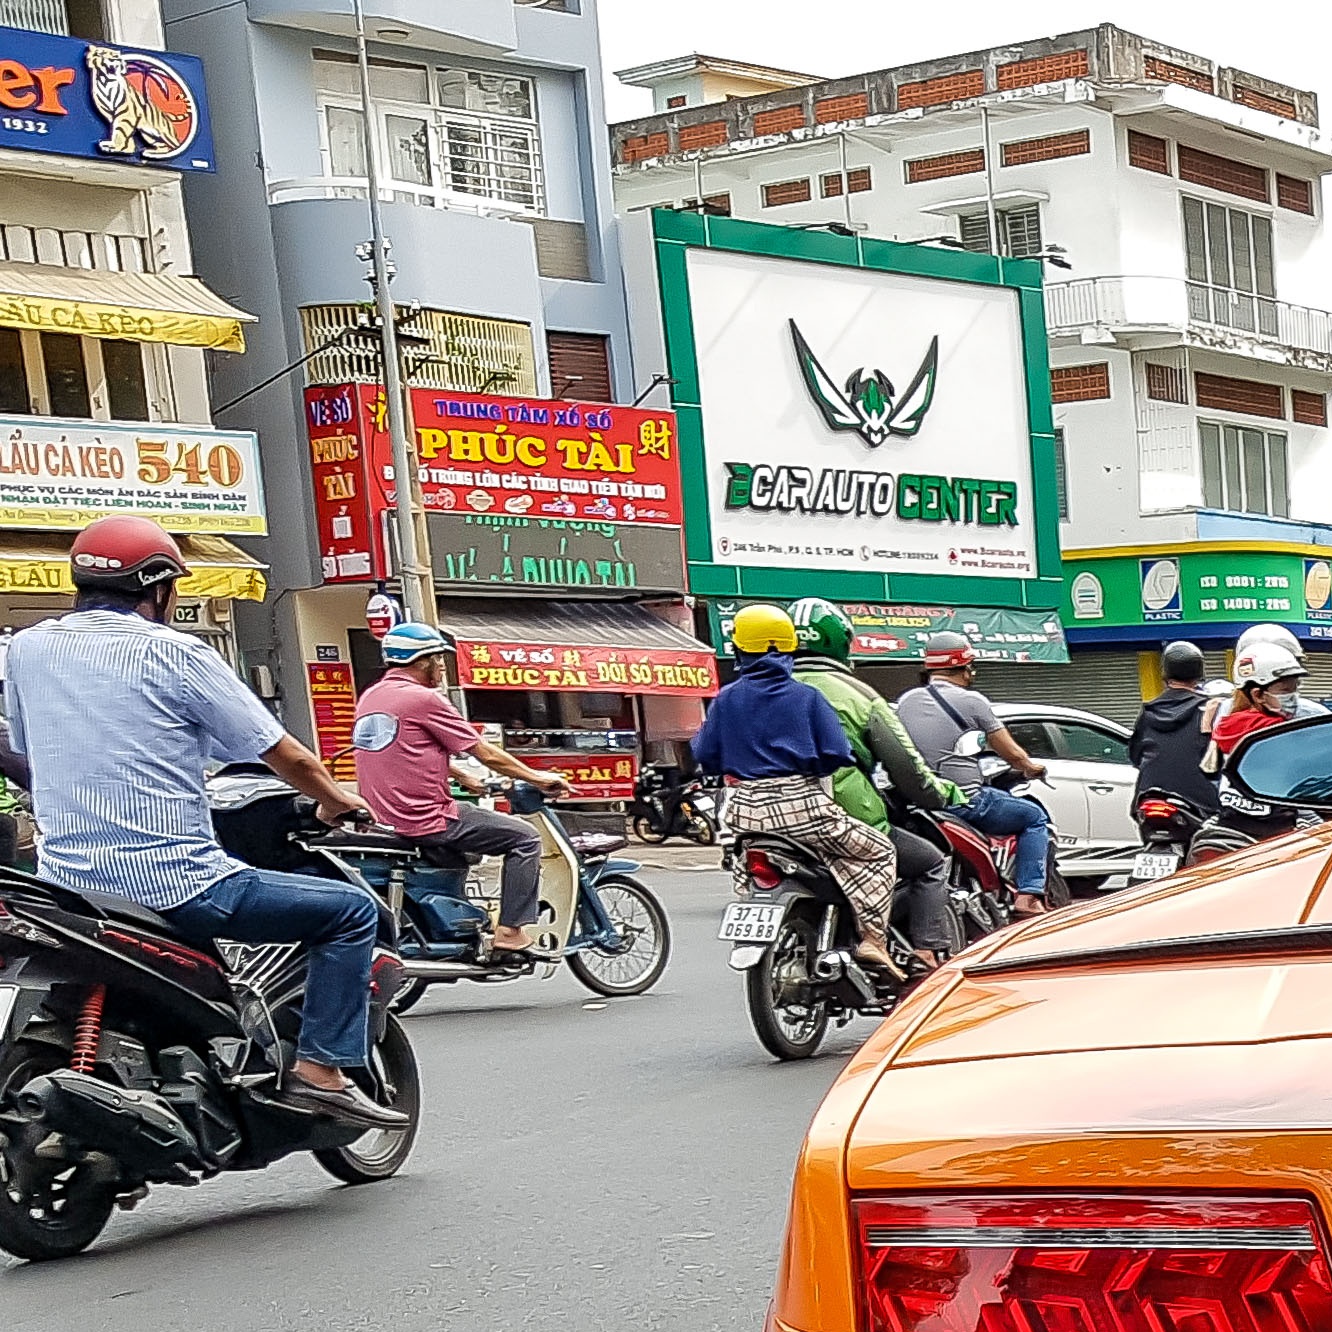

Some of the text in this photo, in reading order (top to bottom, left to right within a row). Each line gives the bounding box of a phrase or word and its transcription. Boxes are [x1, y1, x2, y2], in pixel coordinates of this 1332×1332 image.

[2, 117, 49, 134] 1932
[97, 308, 154, 336] KÈO
[434, 399, 501, 420] TRUNG
[505, 403, 548, 425] TÂM
[585, 407, 613, 430] SỐ
[416, 424, 636, 473] PHÚC TÀI
[637, 420, 673, 460] 財
[78, 436, 125, 480] KÈO
[136, 437, 244, 488] 540
[1, 484, 35, 494] PHỤC
[38, 486, 55, 496] VỤ
[59, 486, 84, 496] CÁC
[813, 468, 896, 517] AUTO
[897, 474, 1020, 526] CENTER
[136, 500, 172, 509] HOAN
[181, 501, 210, 511] SINH
[1200, 576, 1218, 588] ISO
[1200, 599, 1218, 611] ISO
[1144, 611, 1182, 621] PLASTIC
[500, 648, 555, 665] VÉ SỐ
[471, 652, 711, 688] PHÚC TÀI ĐỔI SỐ TRÚNG
[733, 908, 775, 922] 37-L1
